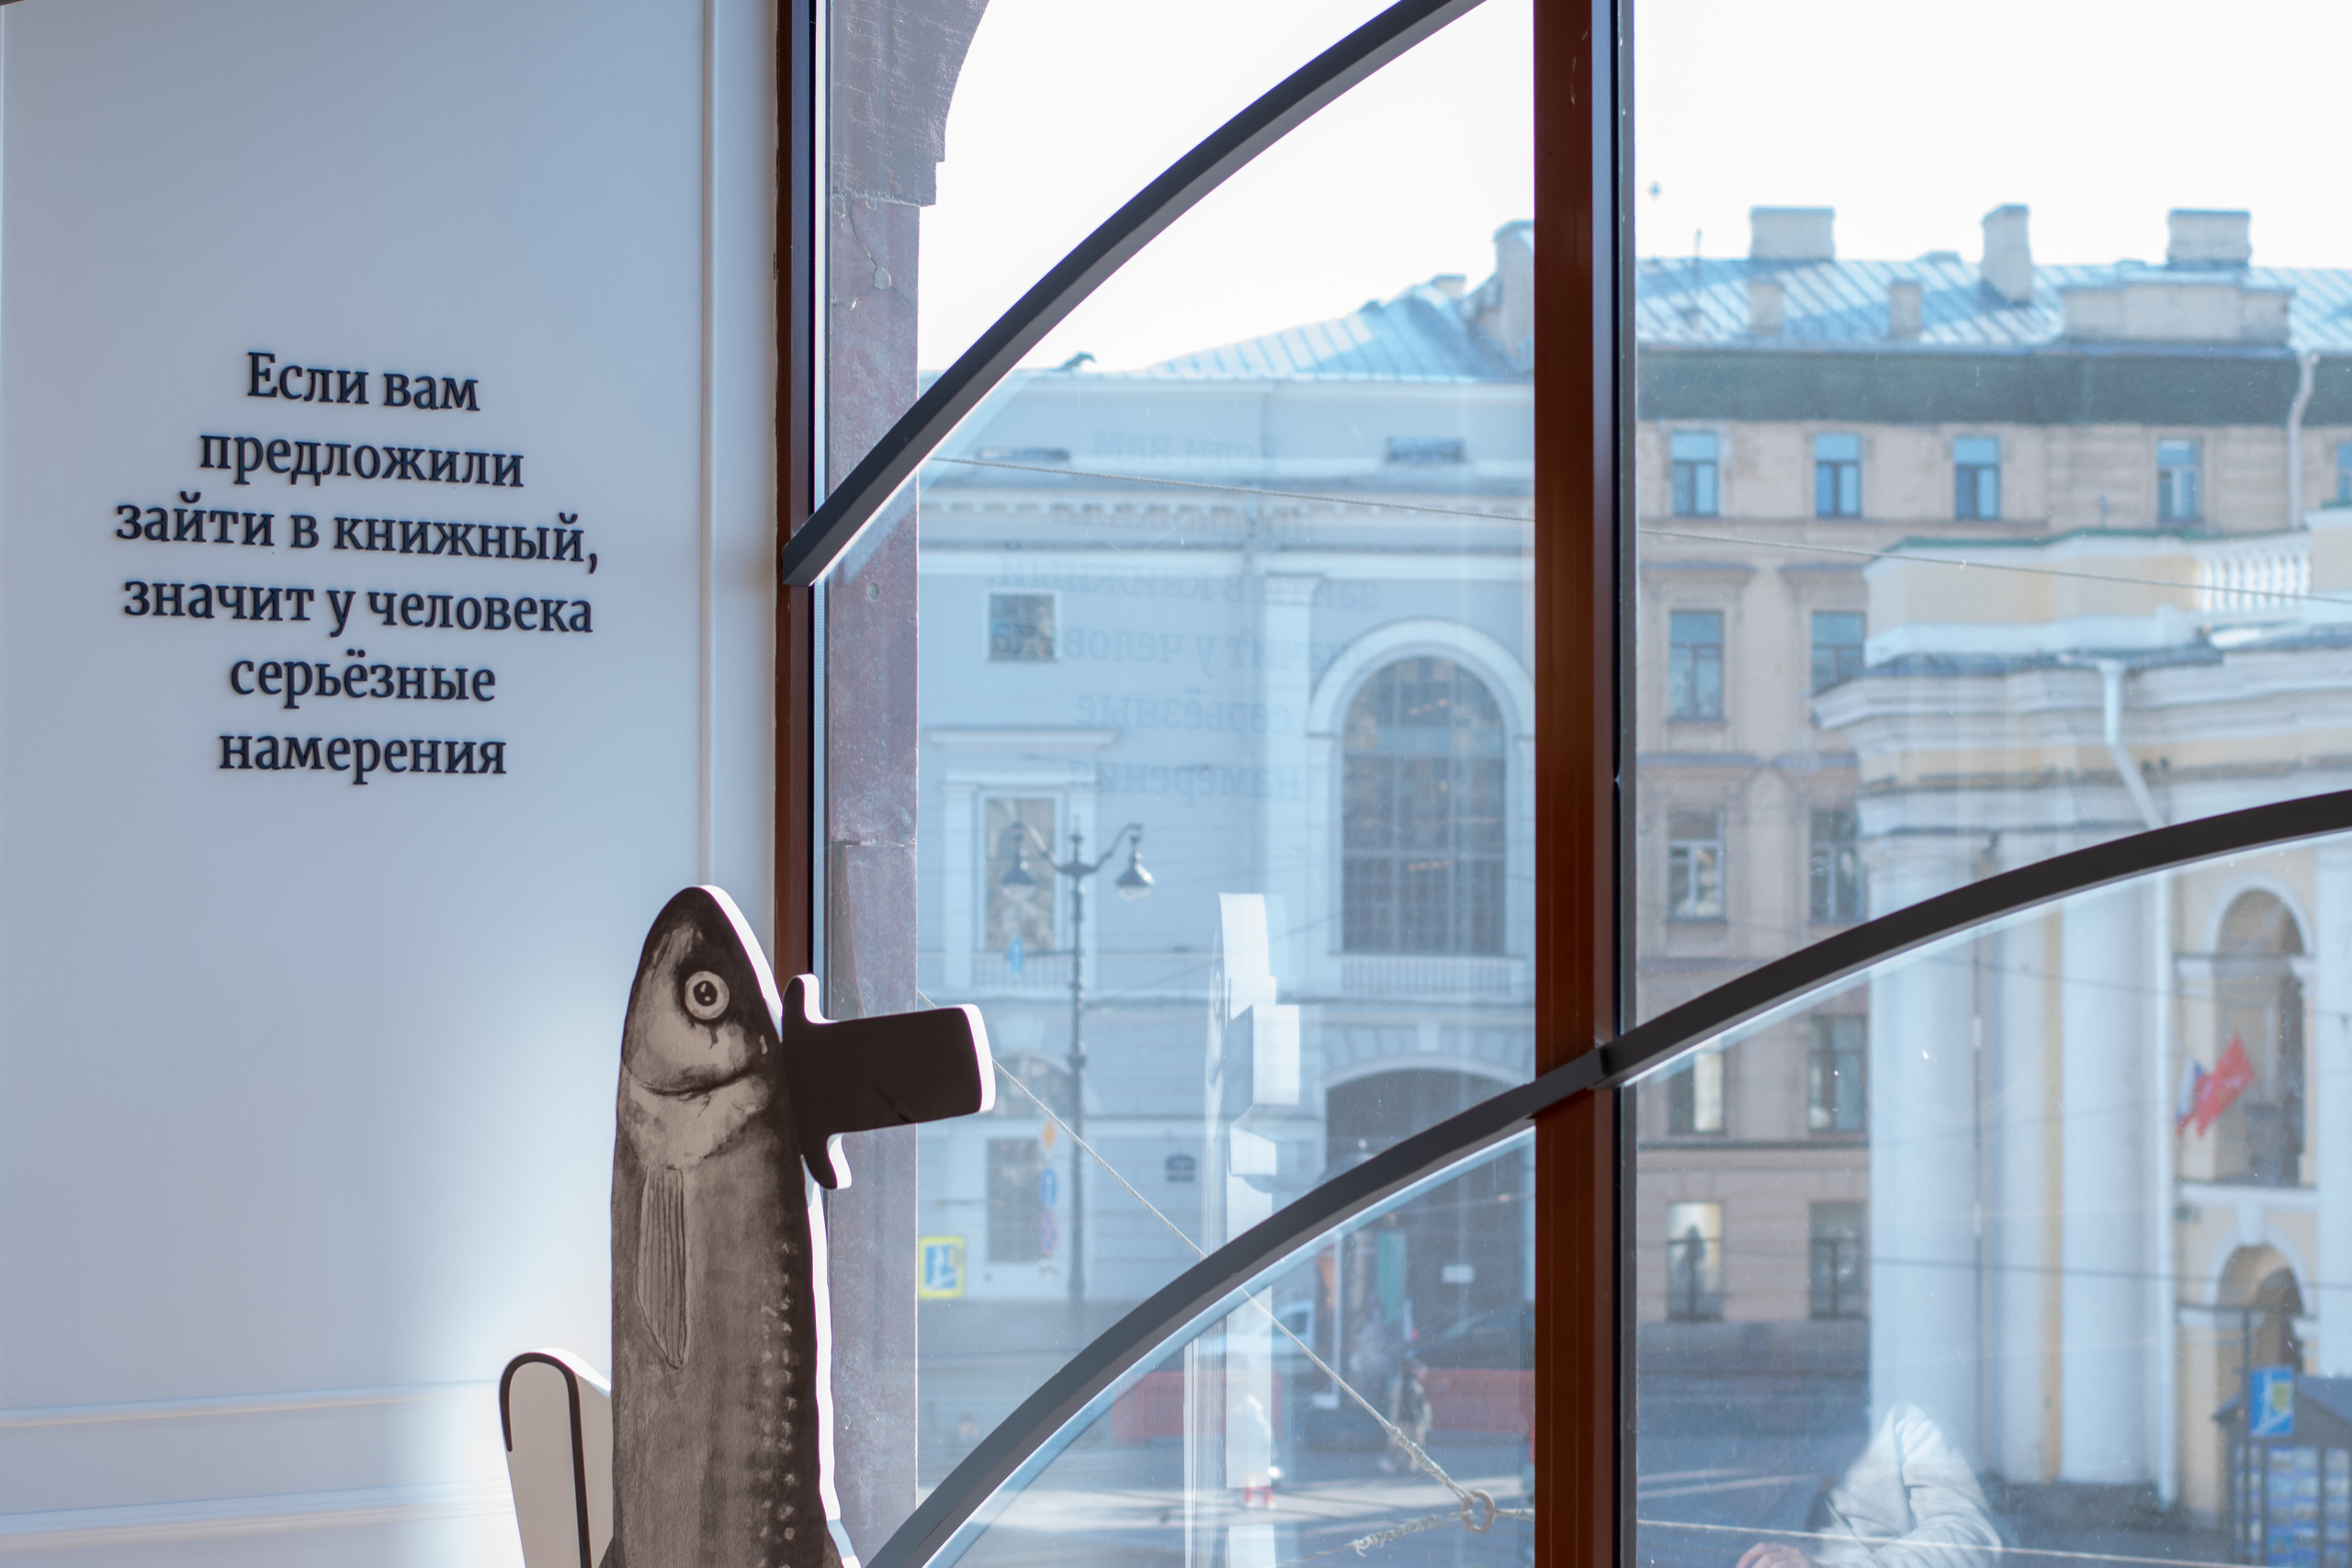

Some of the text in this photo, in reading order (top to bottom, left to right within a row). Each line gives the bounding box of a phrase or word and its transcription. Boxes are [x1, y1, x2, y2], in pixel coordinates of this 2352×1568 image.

[246, 351, 481, 412] Если вам
[199, 434, 525, 488] предложили
[116, 490, 598, 574] зайти в книжный,
[123, 580, 594, 638] значит у человека
[230, 648, 496, 710] серьёзные
[219, 735, 507, 785] намерения
